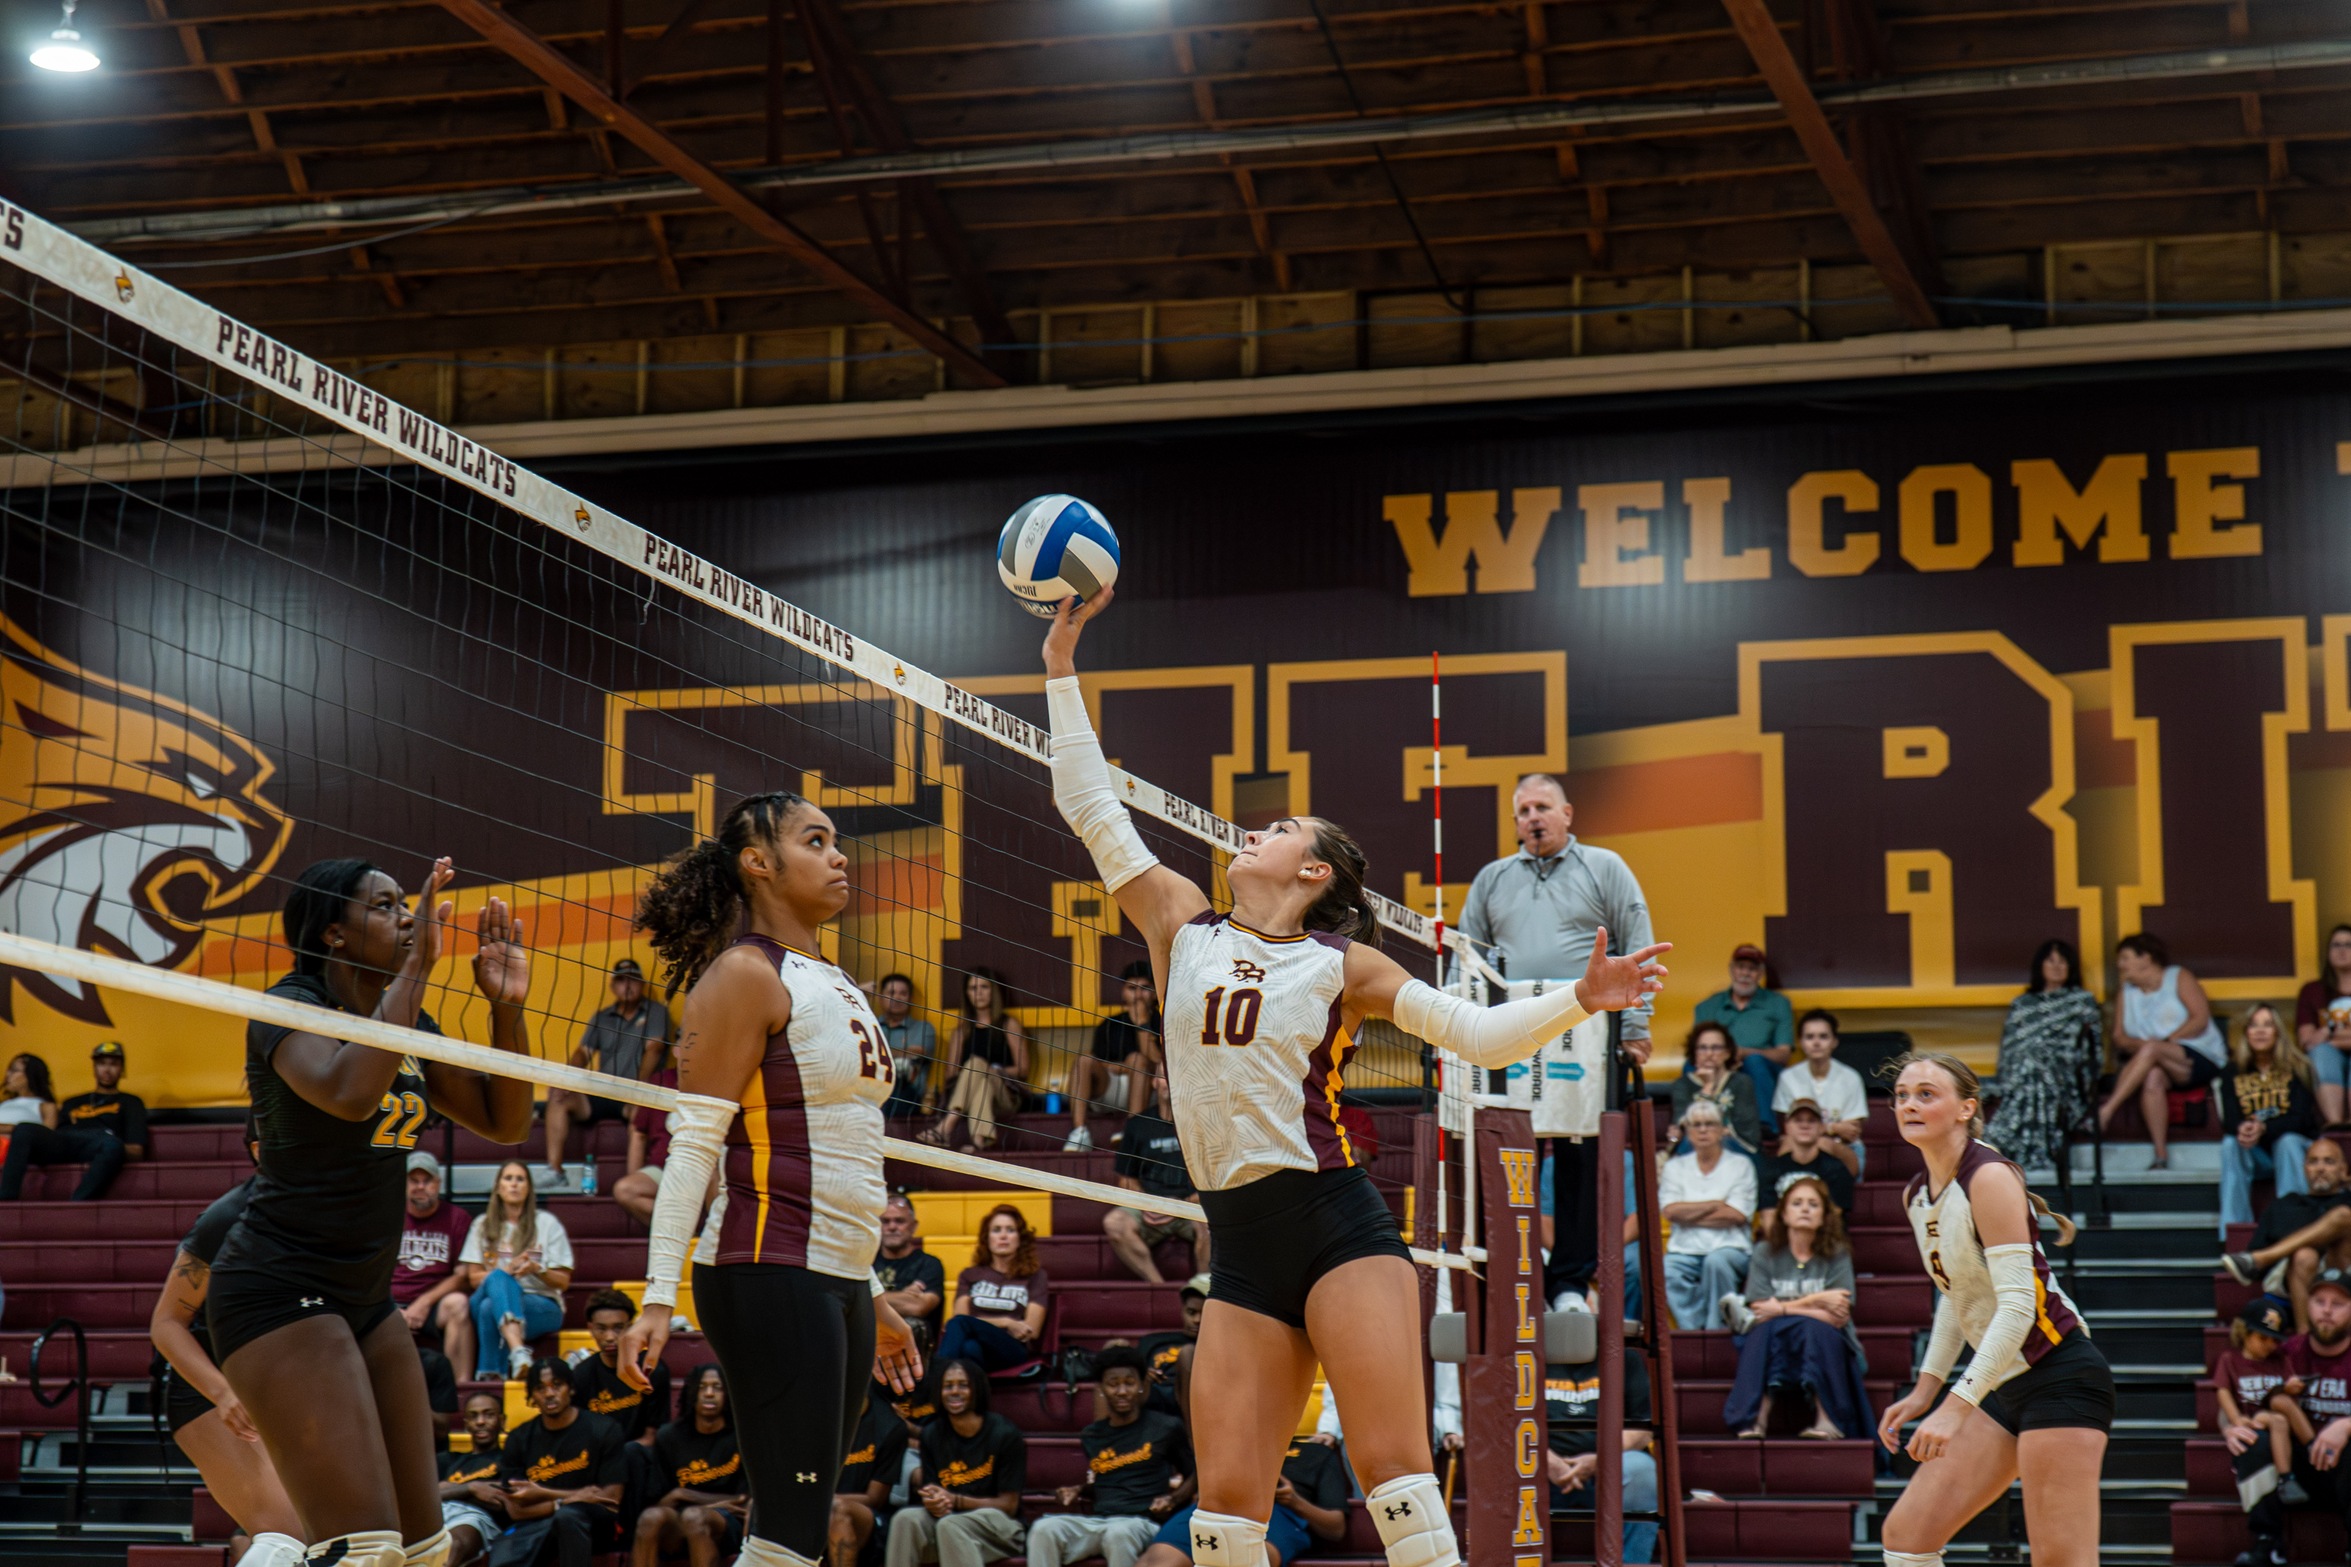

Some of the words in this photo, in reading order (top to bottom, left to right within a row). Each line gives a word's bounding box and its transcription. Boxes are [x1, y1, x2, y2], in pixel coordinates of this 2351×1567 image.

[216, 315, 302, 392] PEARL
[313, 363, 388, 434] RIVER
[398, 407, 517, 498] WILDCATS
[1382, 446, 2264, 598] WELCOME
[643, 532, 705, 589] PEARL
[710, 564, 764, 619] RIVER
[769, 595, 855, 662] WILDCATS
[944, 683, 988, 728] PEARL
[991, 706, 1032, 749] RIVER
[1164, 791, 1198, 828] PEARL
[1200, 809, 1229, 843] RIVER
[1738, 612, 2351, 1010] RI
[849, 1018, 893, 1084] 24
[1201, 986, 1264, 1048] 10
[371, 1091, 428, 1150] 22
[1498, 1147, 1545, 1567] WILDCA
